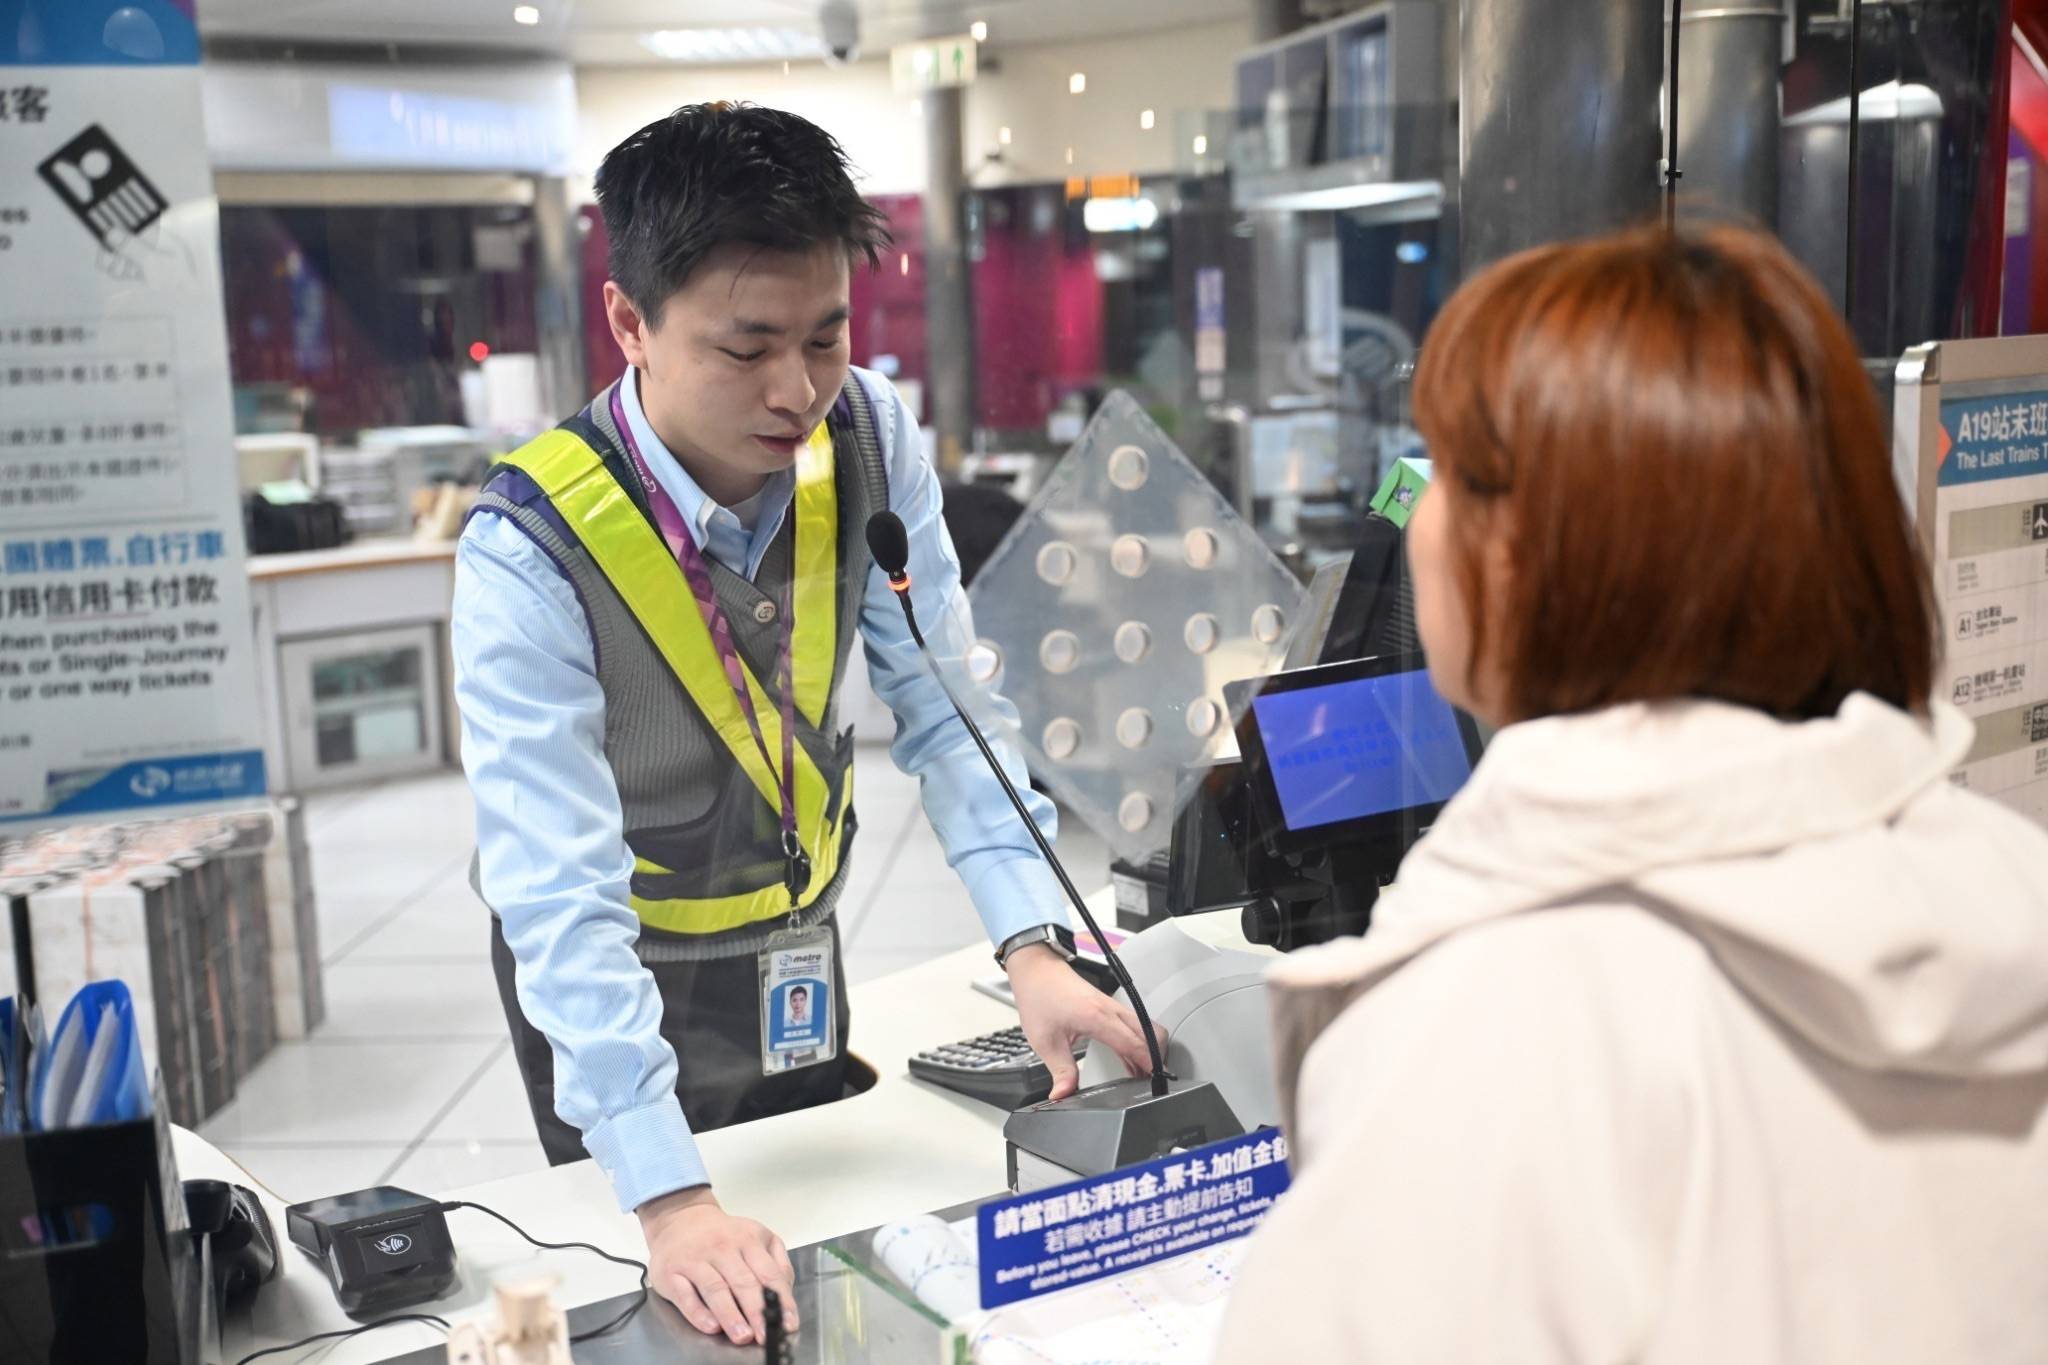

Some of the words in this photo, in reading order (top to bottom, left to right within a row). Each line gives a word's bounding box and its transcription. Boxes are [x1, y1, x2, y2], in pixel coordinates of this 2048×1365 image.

[1957, 451, 1978, 469] The
[1980, 449, 2004, 467] Last
[2007, 444, 2040, 464] Trains
[0, 574, 218, 620] 用信用卡付款
[52, 622, 178, 650] purchasing
[184, 620, 219, 638] the
[1959, 617, 1971, 634] A1
[28, 659, 51, 675] or
[9, 685, 32, 700] or
[40, 681, 82, 698] one
[88, 679, 131, 698] way
[138, 671, 212, 690] tickets
[793, 954, 822, 963] metro
[1045, 1212, 1124, 1254] 若需收據
[1126, 1177, 1253, 1231] 請主動提前告知
[996, 1264, 1036, 1284] Before
[1036, 1258, 1060, 1275] you
[1094, 1238, 1131, 1258] please
[1132, 1224, 1171, 1246] CHECK
[1172, 1219, 1196, 1236] your
[1104, 1256, 1114, 1270] A
[1115, 1245, 1152, 1266] receipt
[1153, 1243, 1164, 1255] is
[1165, 1230, 1210, 1251] available
[1211, 1226, 1226, 1238] on
